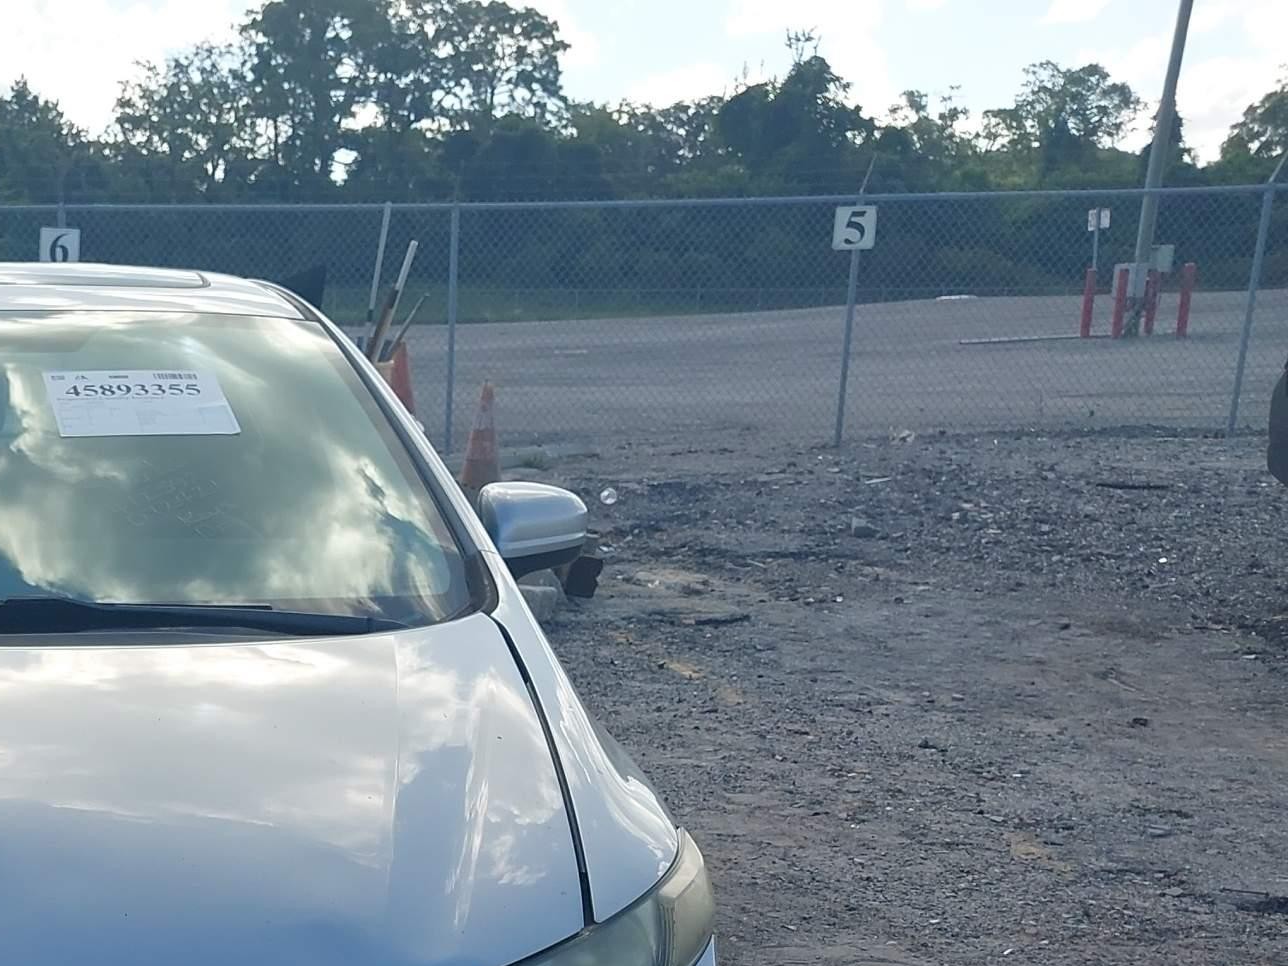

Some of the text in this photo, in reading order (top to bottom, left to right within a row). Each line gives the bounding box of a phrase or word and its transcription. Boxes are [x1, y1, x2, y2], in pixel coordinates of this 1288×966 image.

[844, 211, 868, 245] 5
[49, 233, 71, 262] 6
[65, 383, 201, 397] 45893355
